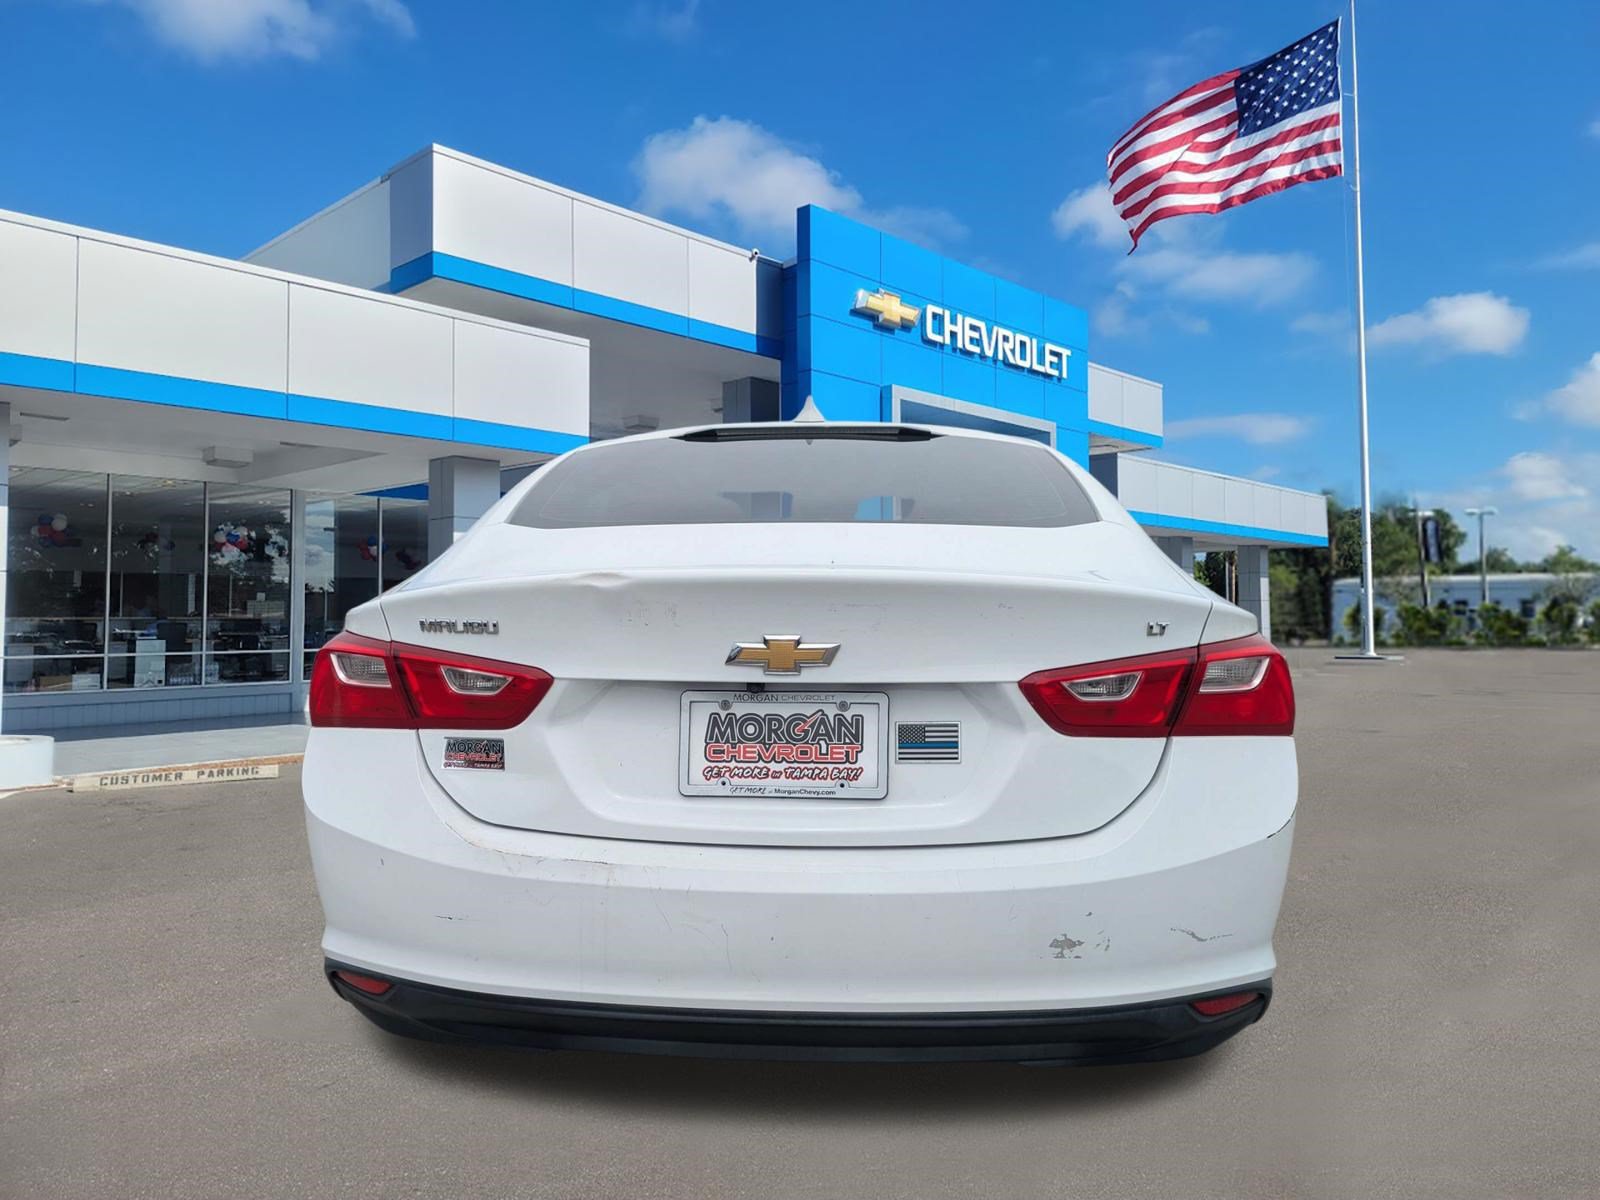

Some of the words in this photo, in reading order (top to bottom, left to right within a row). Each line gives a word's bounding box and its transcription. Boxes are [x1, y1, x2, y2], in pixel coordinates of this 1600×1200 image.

[925, 304, 1071, 379] CHEVROLET
[419, 619, 499, 635] MALIBU
[1146, 621, 1170, 637] LT
[733, 694, 779, 702] MORGAN
[781, 694, 835, 702] CHEVROLET
[705, 709, 864, 744] MORGAN
[446, 740, 502, 753] MORGAN
[706, 743, 862, 763] CHEVROLET
[100, 772, 183, 787] CUSTOMER
[196, 766, 260, 779] PARKING
[703, 765, 731, 780] GET
[730, 766, 770, 779] MORE
[784, 766, 828, 780] TAMPA
[830, 766, 864, 781] BAY!
[774, 788, 836, 796] MorganChevy.com
